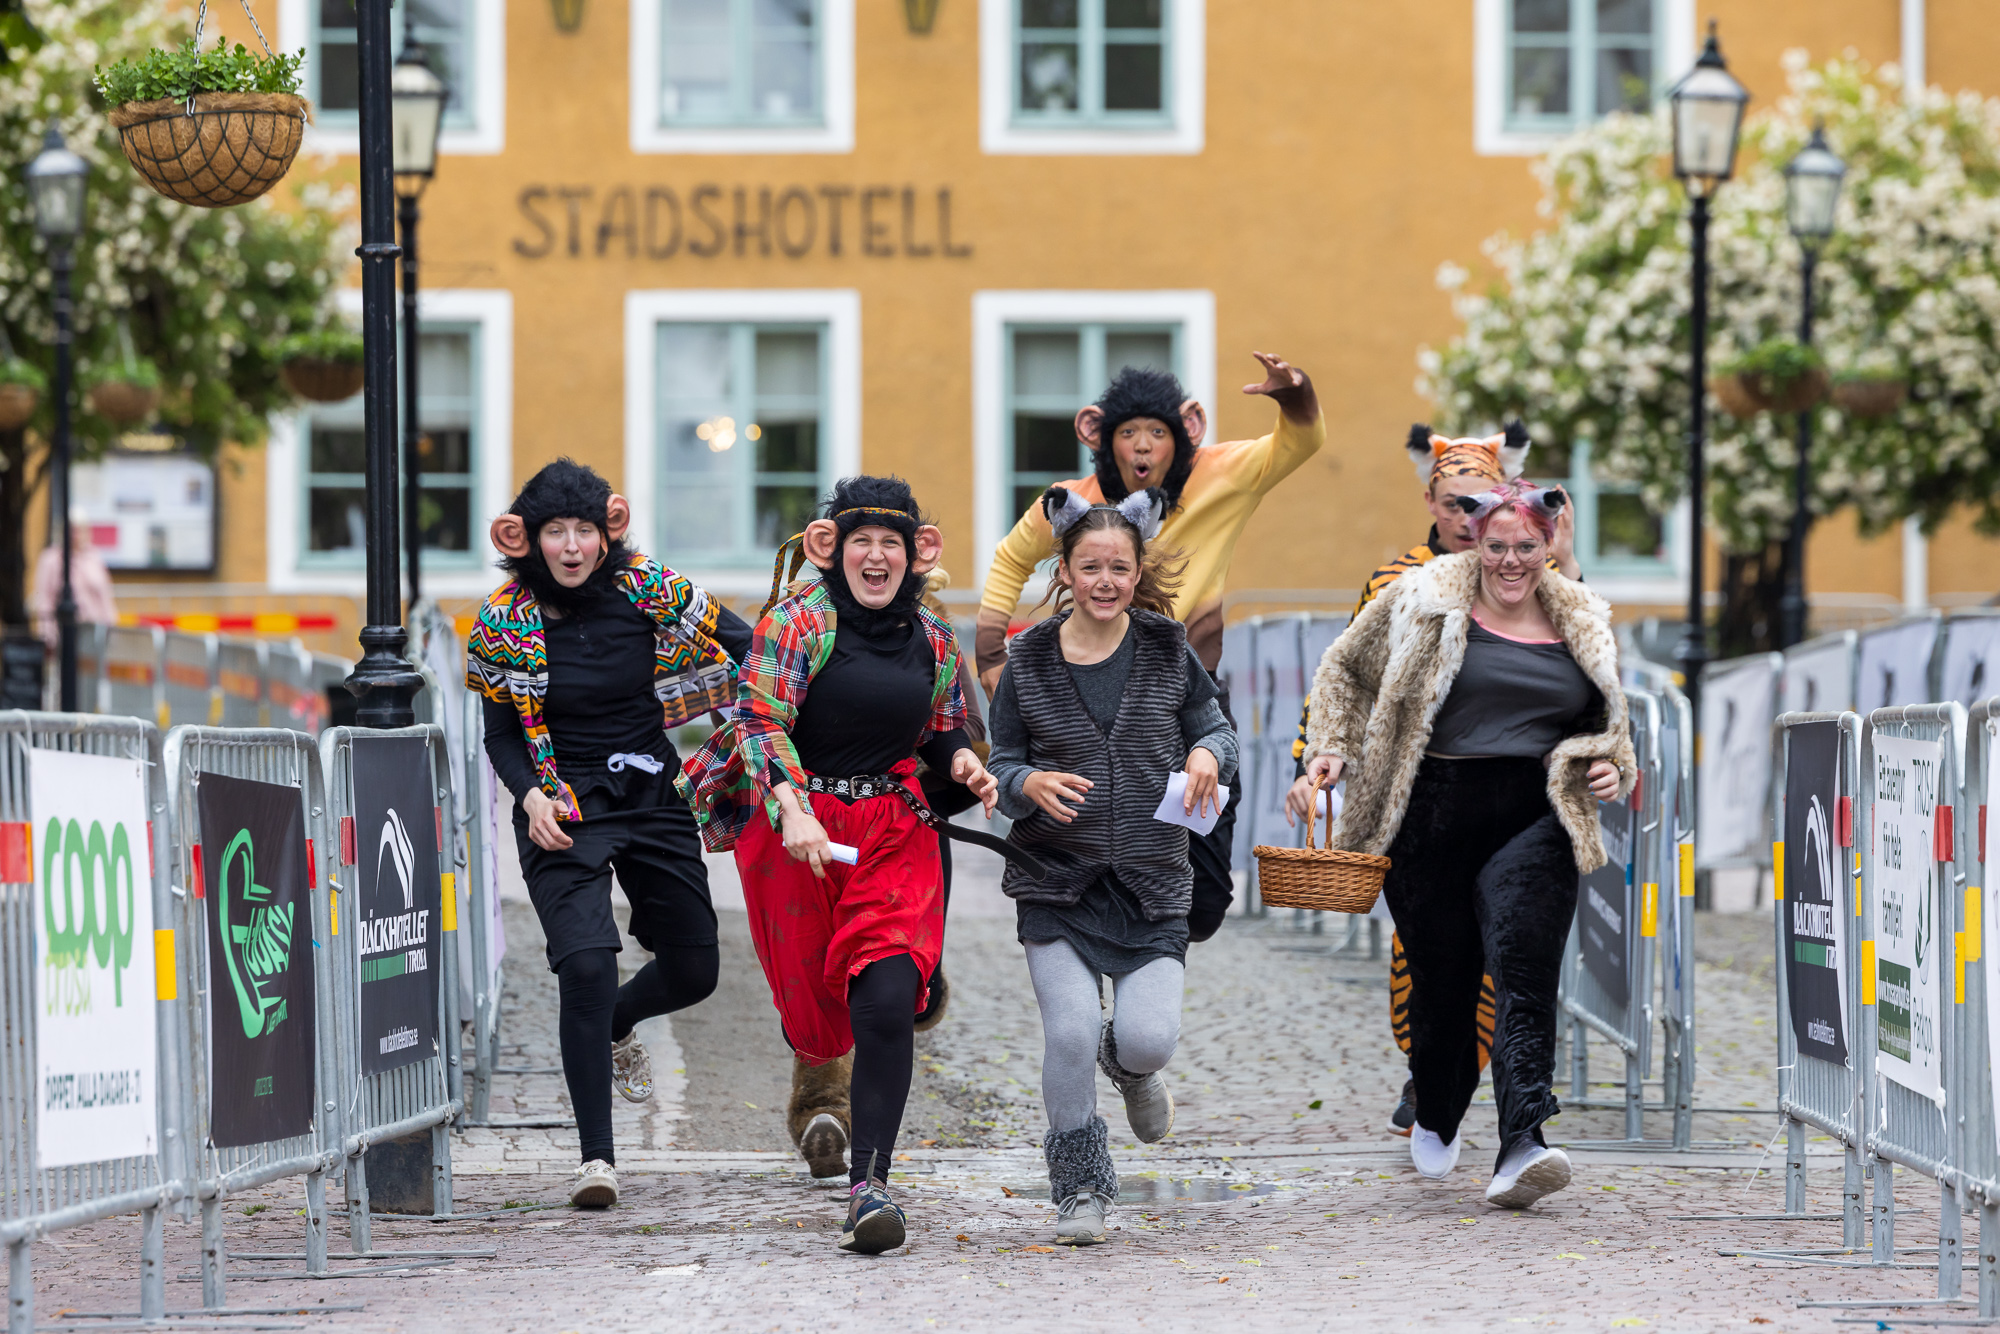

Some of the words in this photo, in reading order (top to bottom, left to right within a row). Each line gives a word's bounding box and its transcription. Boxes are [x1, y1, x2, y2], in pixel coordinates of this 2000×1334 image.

[512, 183, 974, 260] STADSHOTELL
[1912, 759, 1934, 817] TROSA
[43, 816, 134, 1008] coop
[409, 948, 428, 973] TROSA
[45, 1065, 74, 1111] ÖPPET
